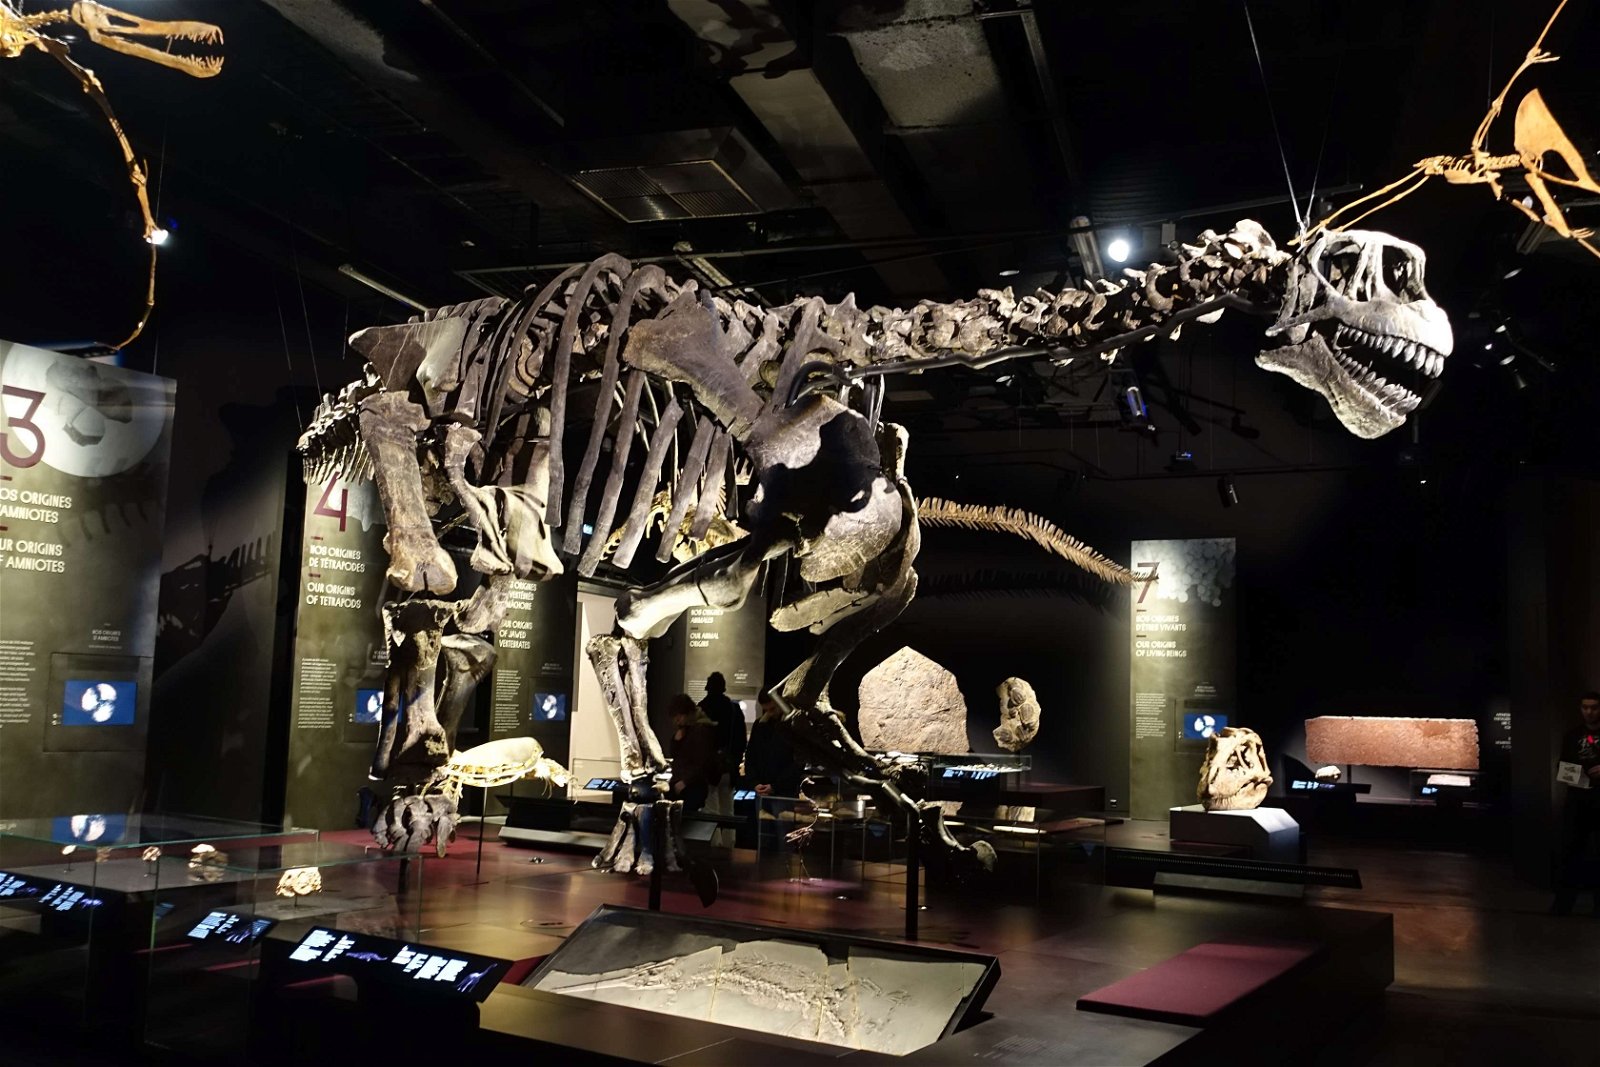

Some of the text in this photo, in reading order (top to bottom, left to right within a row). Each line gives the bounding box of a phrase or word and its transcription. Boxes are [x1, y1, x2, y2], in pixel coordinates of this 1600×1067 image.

[0, 385, 46, 469] 3
[20, 490, 72, 509] ORIGINES
[314, 471, 348, 531] 4
[16, 540, 63, 556] ORIGINS
[309, 545, 361, 560] NOS ORIGINES
[5, 556, 65, 573] AMNIOTES
[309, 557, 365, 573] DE TÉTRAPODES
[307, 582, 355, 596] OUR ORIGINS
[1137, 562, 1160, 604] 7
[306, 595, 361, 609] OF TETRAPODS
[499, 629, 508, 637] OF
[1136, 649, 1146, 657] OF
